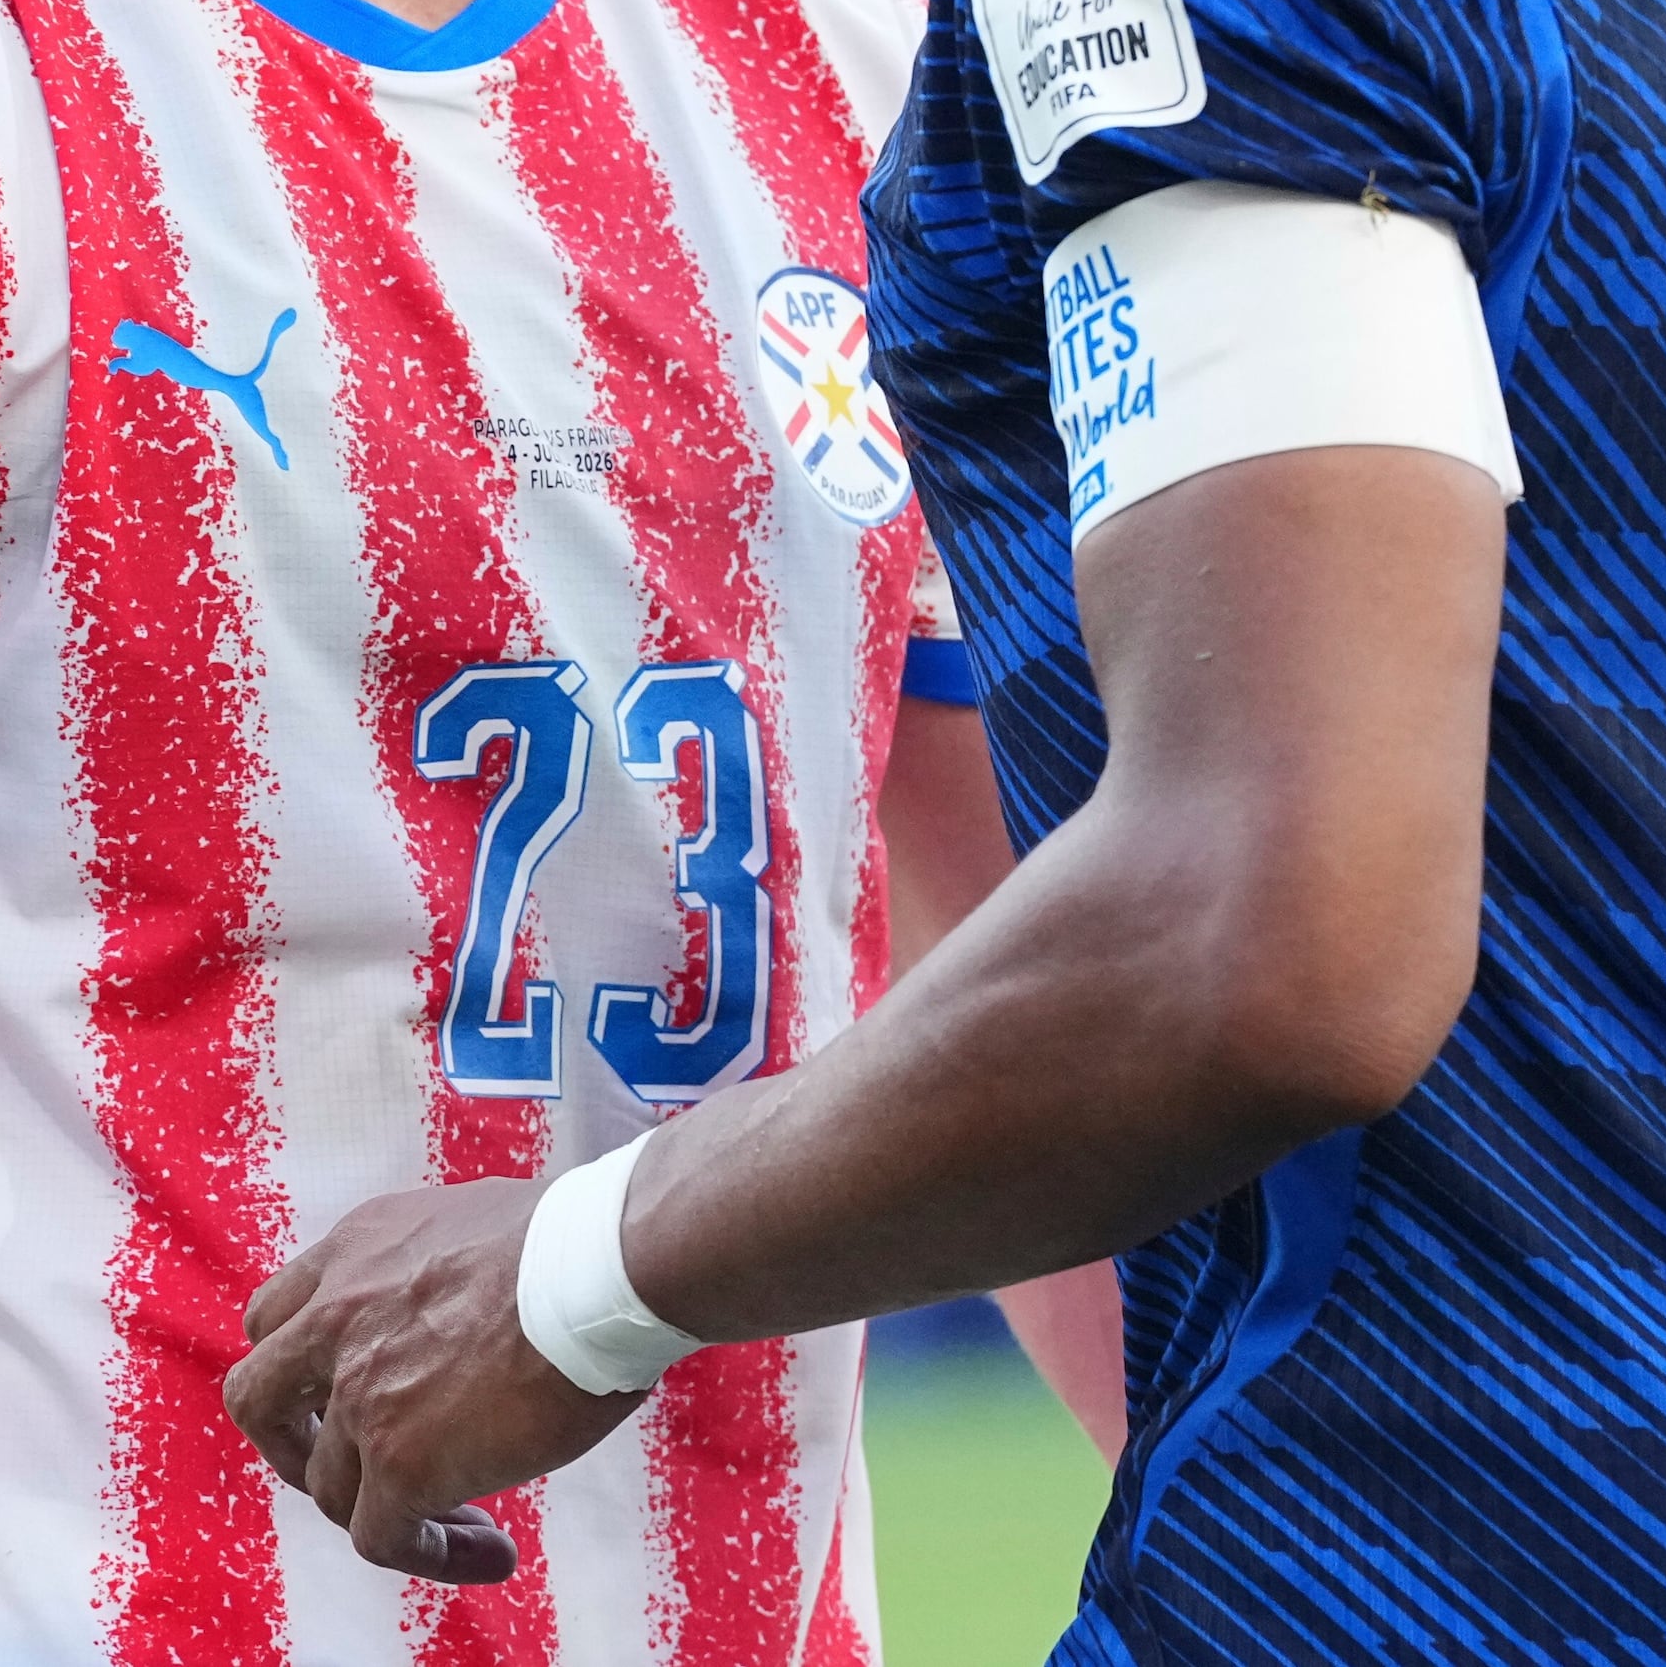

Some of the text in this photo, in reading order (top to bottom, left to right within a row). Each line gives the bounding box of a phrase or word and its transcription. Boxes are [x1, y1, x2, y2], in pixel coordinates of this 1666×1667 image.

[1018, 21, 1149, 108] EDUCATION
[786, 291, 836, 328] APF
[543, 429, 564, 447] VS
[1062, 356, 1155, 468] World
[508, 444, 517, 463] 4
[575, 453, 613, 472] 2026
[412, 659, 774, 1103] 23
